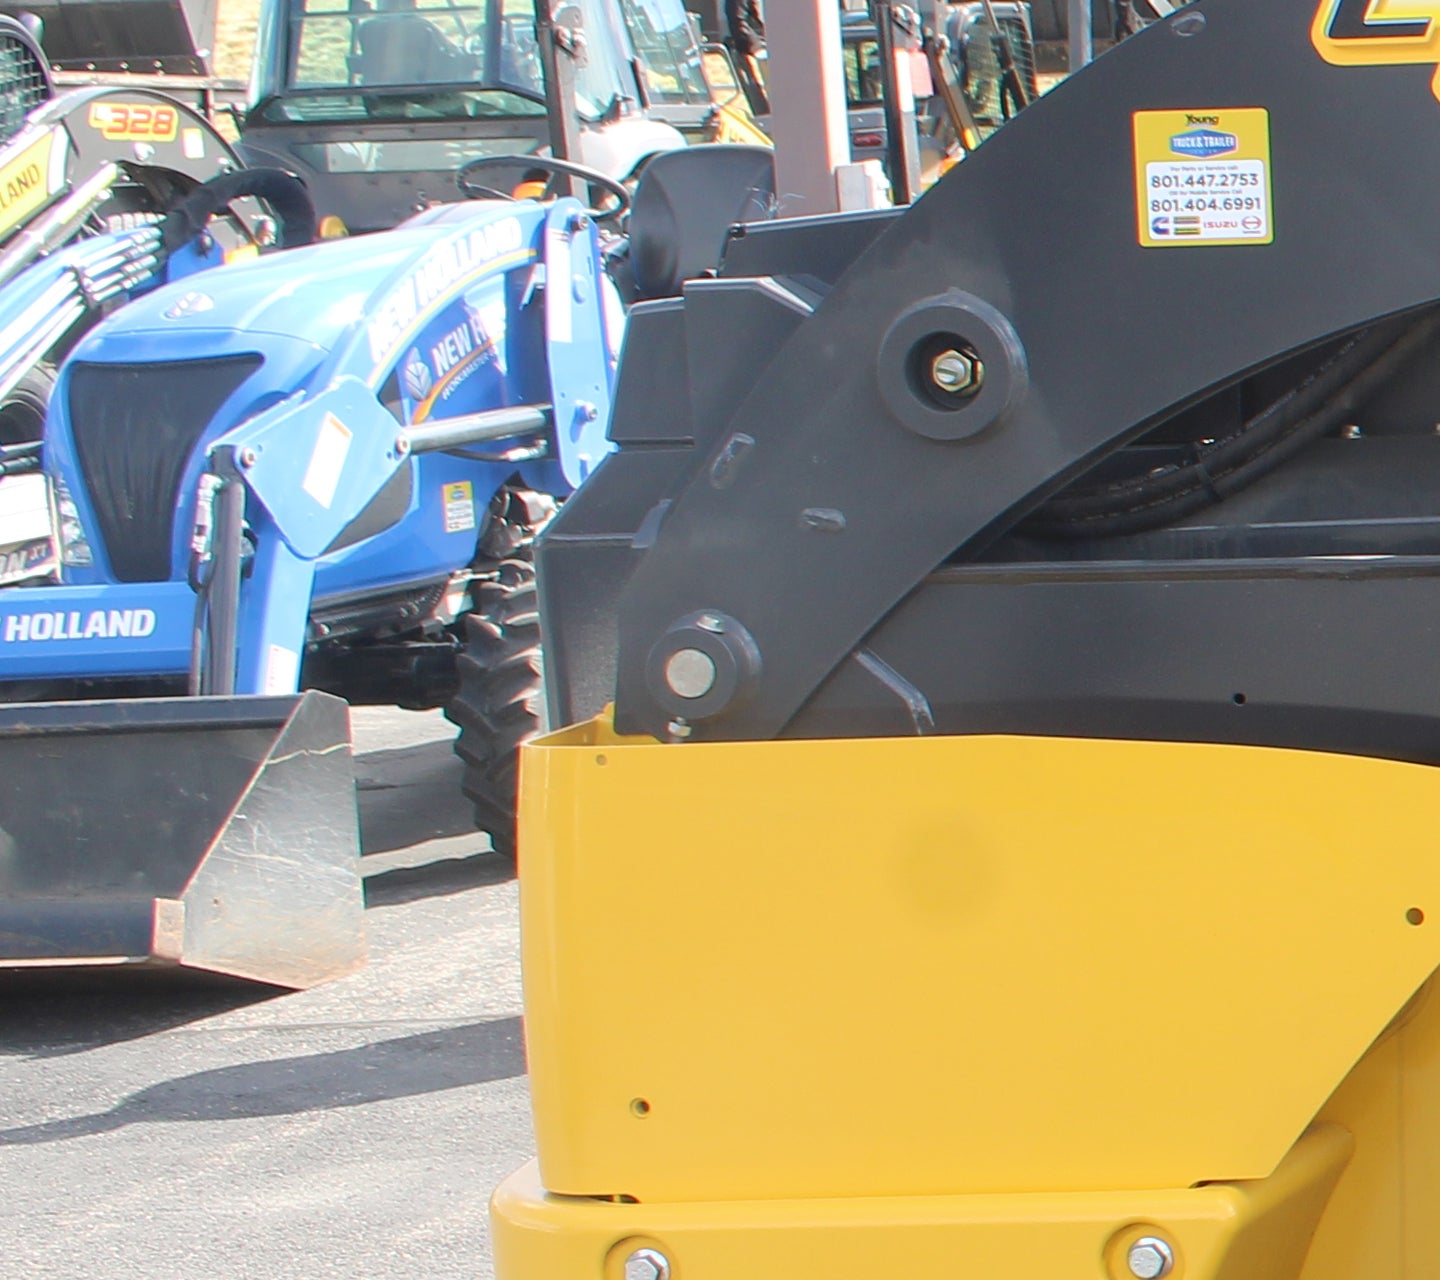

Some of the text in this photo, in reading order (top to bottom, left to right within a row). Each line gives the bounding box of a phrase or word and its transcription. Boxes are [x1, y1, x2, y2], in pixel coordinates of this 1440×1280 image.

[1186, 114, 1219, 126] Young
[1151, 173, 1259, 188] 801.447.2753
[1151, 197, 1261, 212] 801.404.6991
[1203, 221, 1238, 229] ISUZU
[431, 322, 473, 378] NEW
[4, 609, 156, 642] HOLLAND
